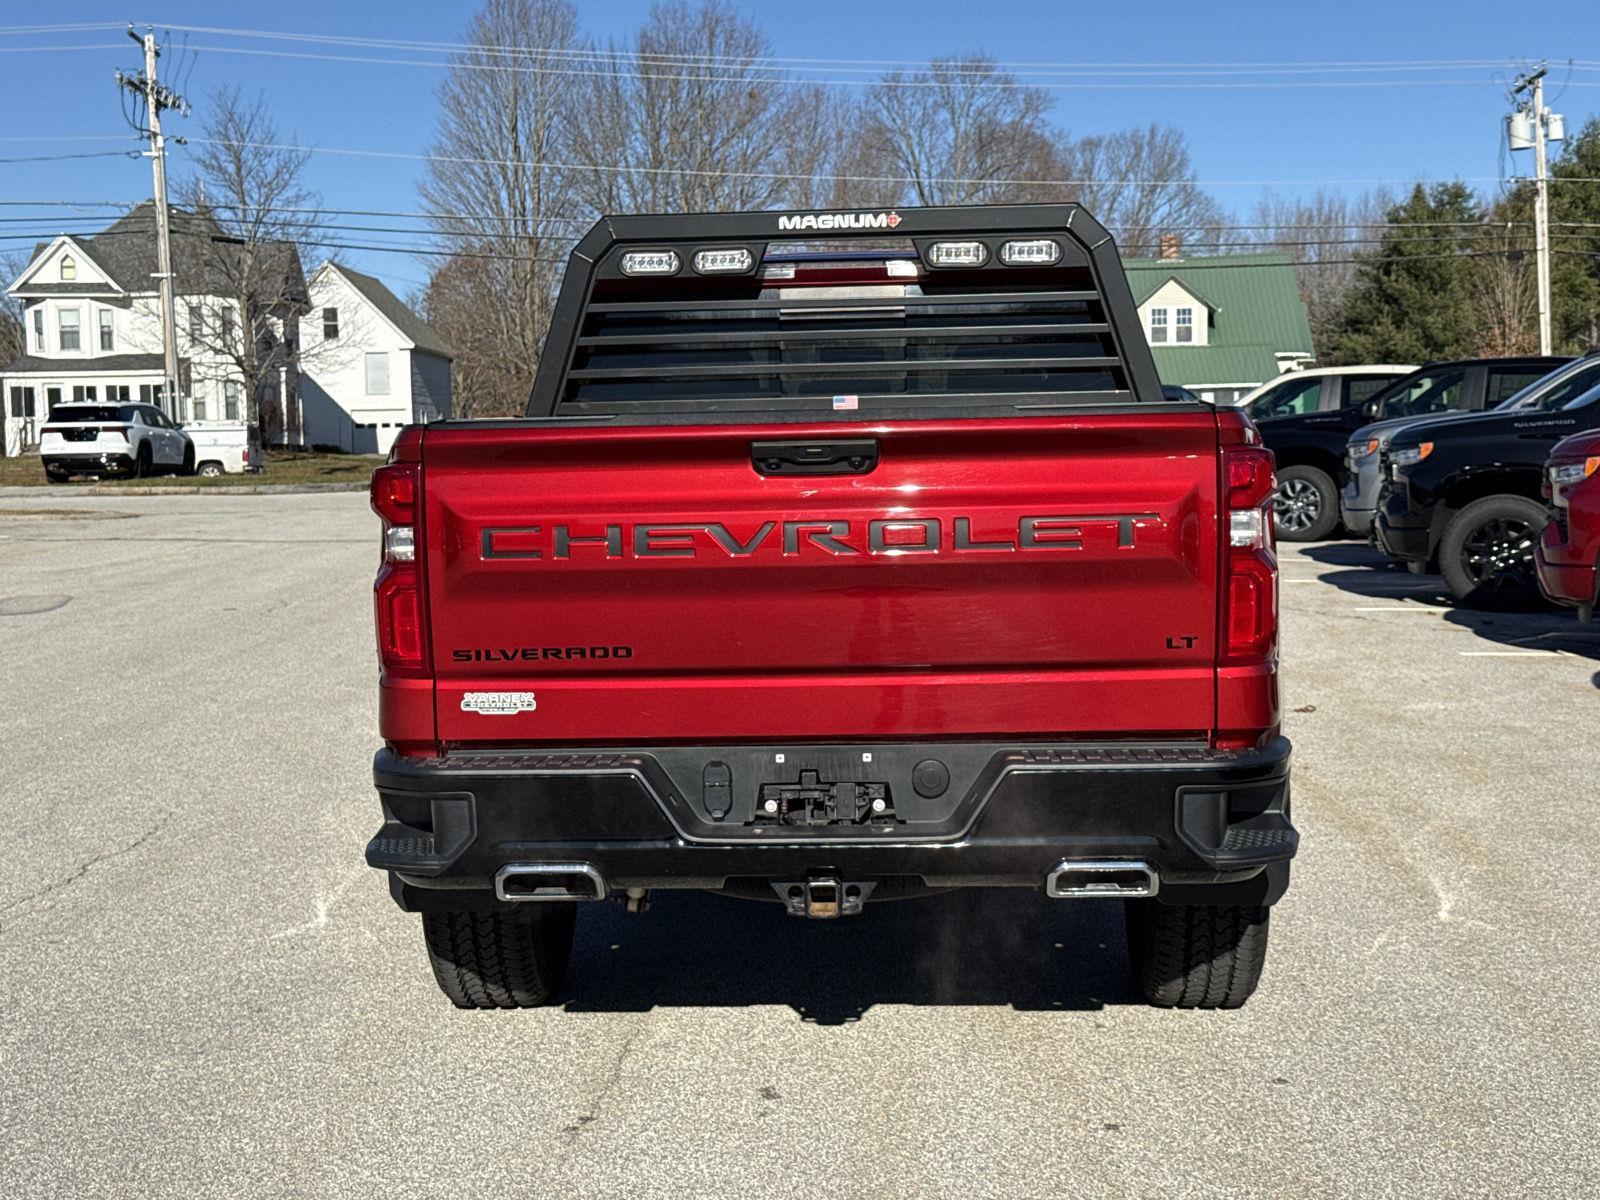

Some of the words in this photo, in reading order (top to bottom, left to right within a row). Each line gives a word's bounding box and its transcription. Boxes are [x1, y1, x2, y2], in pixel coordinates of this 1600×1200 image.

[778, 213, 888, 230] MAGNUM
[480, 512, 1161, 560] CHEVROLET
[1166, 635, 1199, 649] LT
[452, 646, 633, 662] SILVERADO
[465, 693, 534, 703] VARNEY
